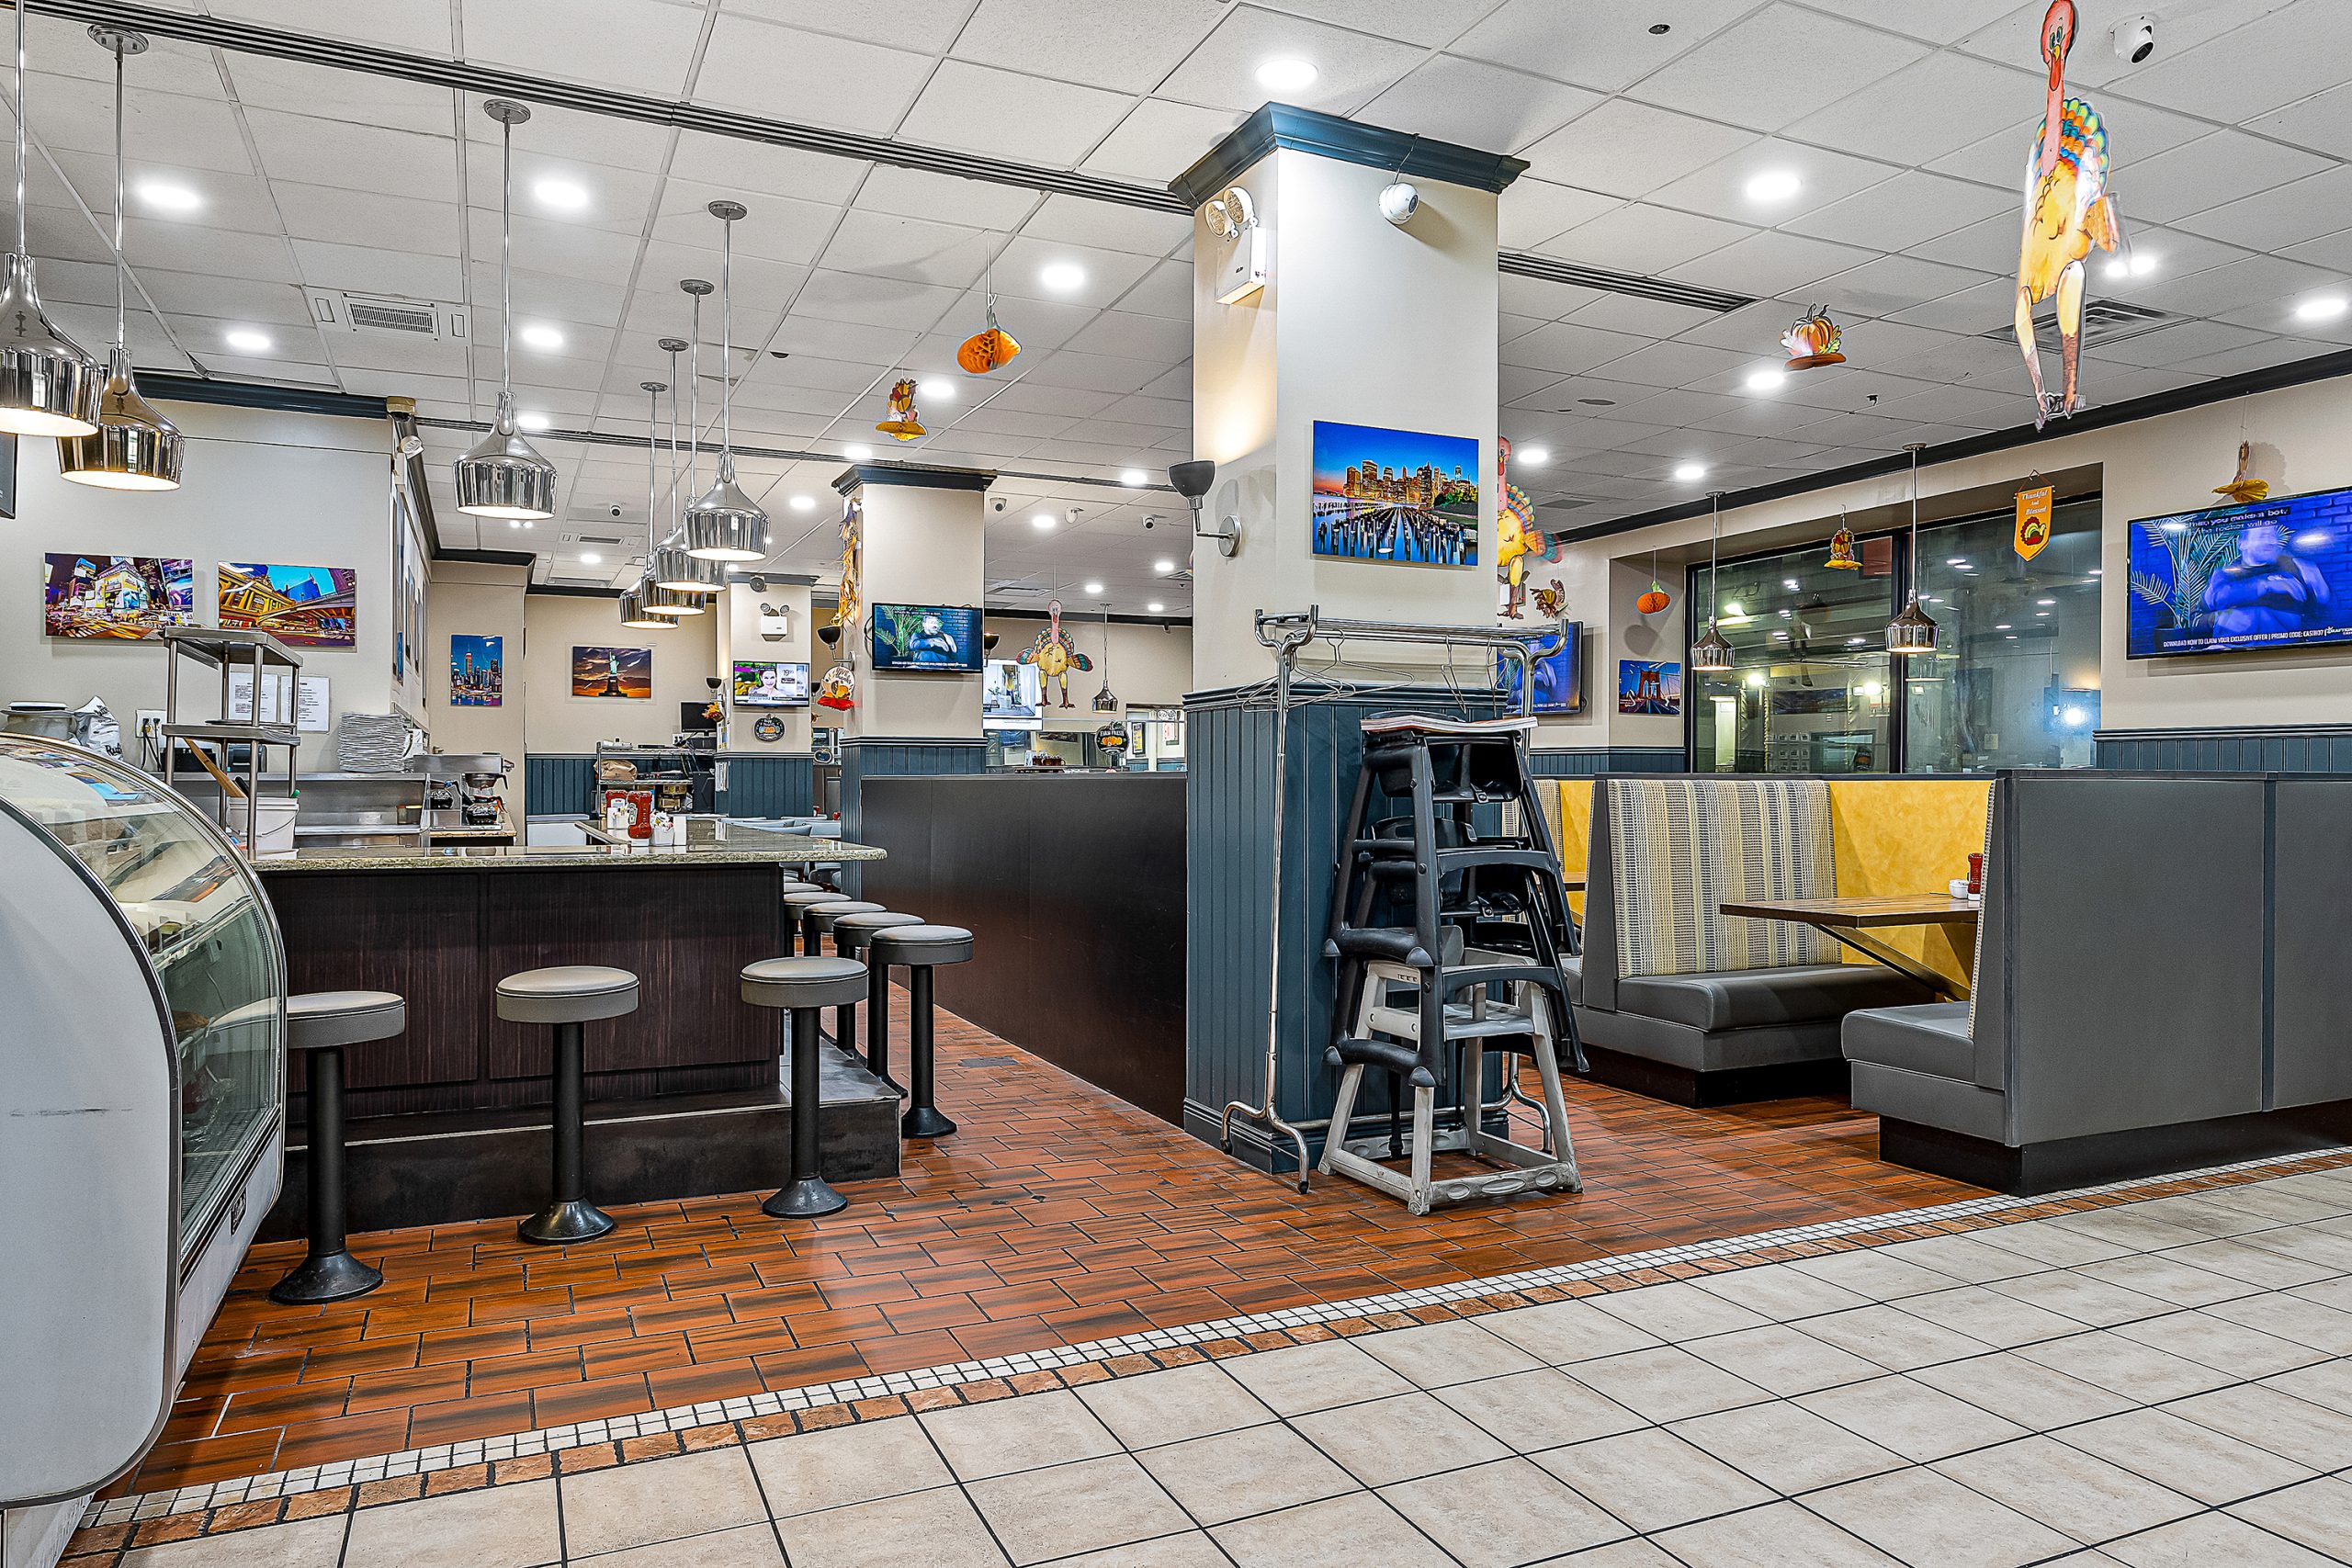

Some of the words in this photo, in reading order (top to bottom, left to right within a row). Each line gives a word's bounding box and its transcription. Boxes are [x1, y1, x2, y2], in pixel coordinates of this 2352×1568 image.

[2021, 490, 2048, 500] Thankful
[2025, 506, 2047, 514] Blessed
[2247, 520, 2264, 528] will
